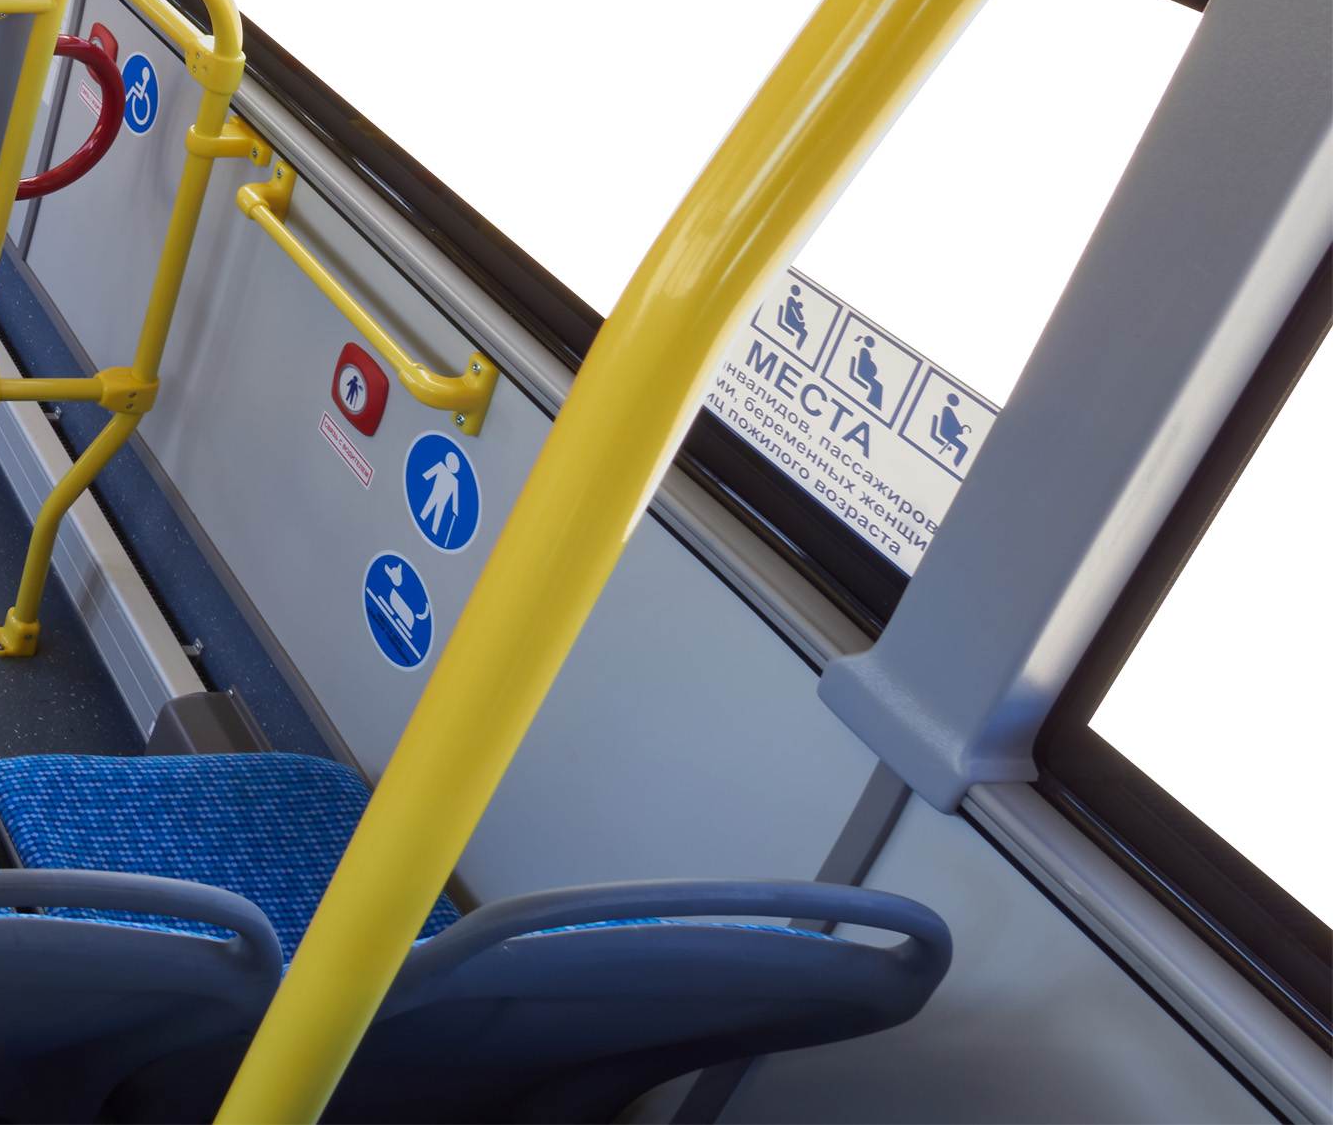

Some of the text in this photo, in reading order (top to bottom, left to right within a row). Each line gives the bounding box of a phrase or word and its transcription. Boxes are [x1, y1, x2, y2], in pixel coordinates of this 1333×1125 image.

[342, 443, 370, 479] ВОДИТЕЛЕМ
[723, 361, 938, 535] нвалидов, пассажиров
[745, 339, 870, 459] МЕСТА
[728, 408, 810, 481] пожилого
[814, 479, 901, 555] возраста
[744, 396, 928, 551] беременных женщи
